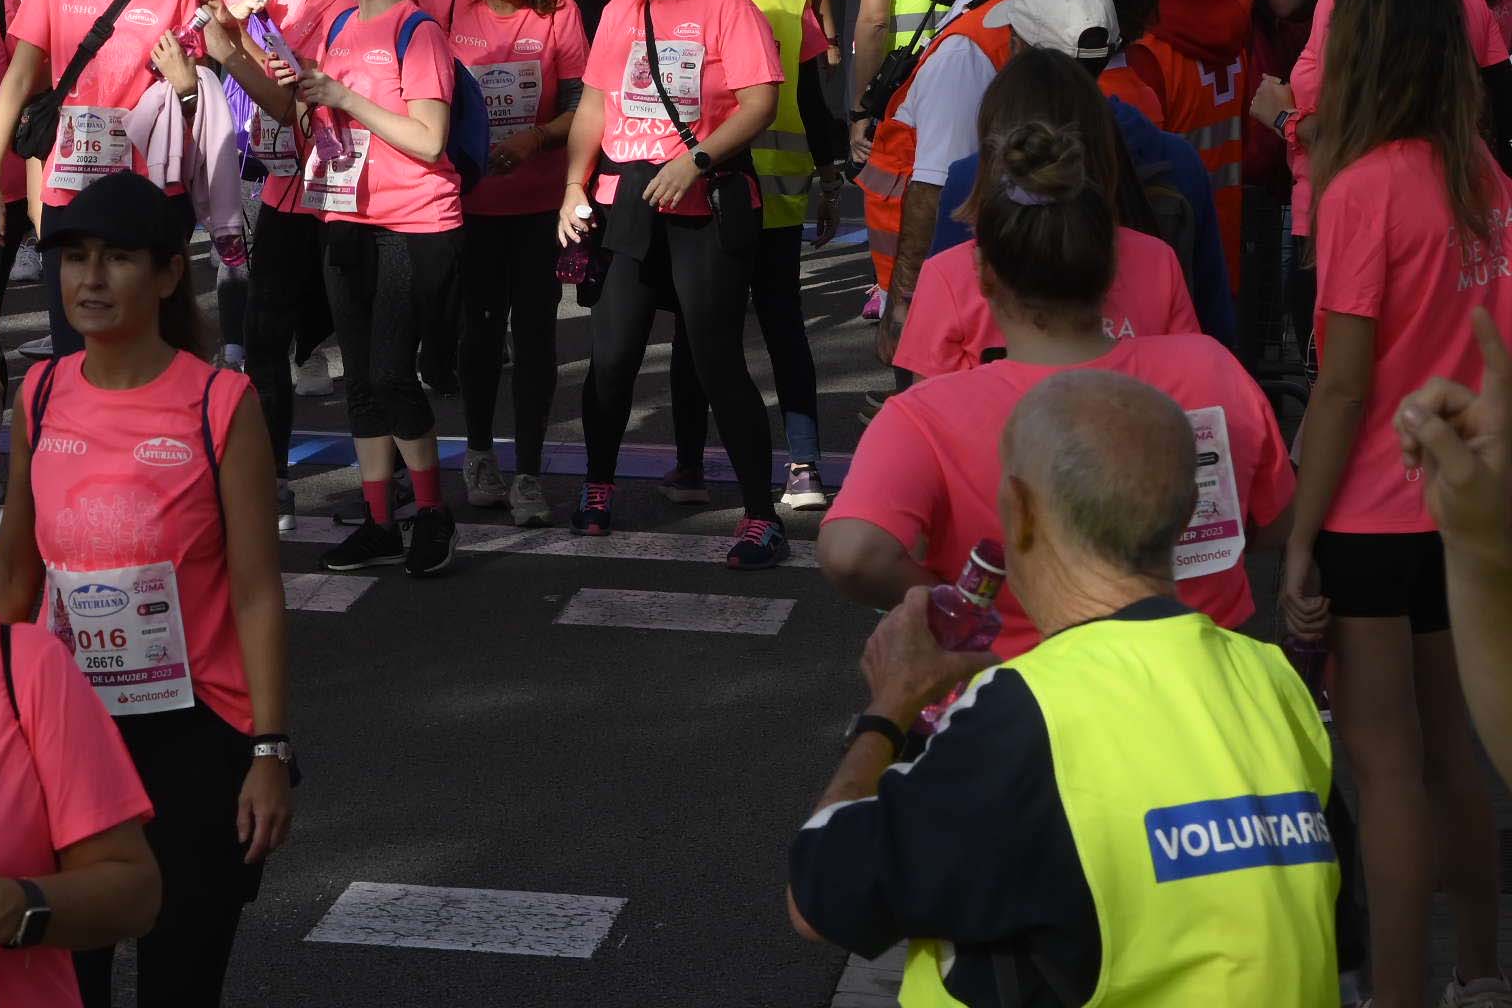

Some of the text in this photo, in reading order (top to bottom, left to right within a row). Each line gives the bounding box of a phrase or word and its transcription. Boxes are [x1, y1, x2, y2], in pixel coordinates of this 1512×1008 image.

[485, 94, 513, 106] 016
[75, 139, 101, 152] 016
[39, 438, 86, 455] OYSHO
[1176, 548, 1232, 566] Santander
[134, 583, 165, 594] SUMA
[72, 596, 124, 610] ASTURIANA
[78, 628, 127, 650] 016
[86, 656, 124, 669] 26676
[92, 669, 173, 683] DE LA MUJER 2023
[129, 687, 180, 703] Santander
